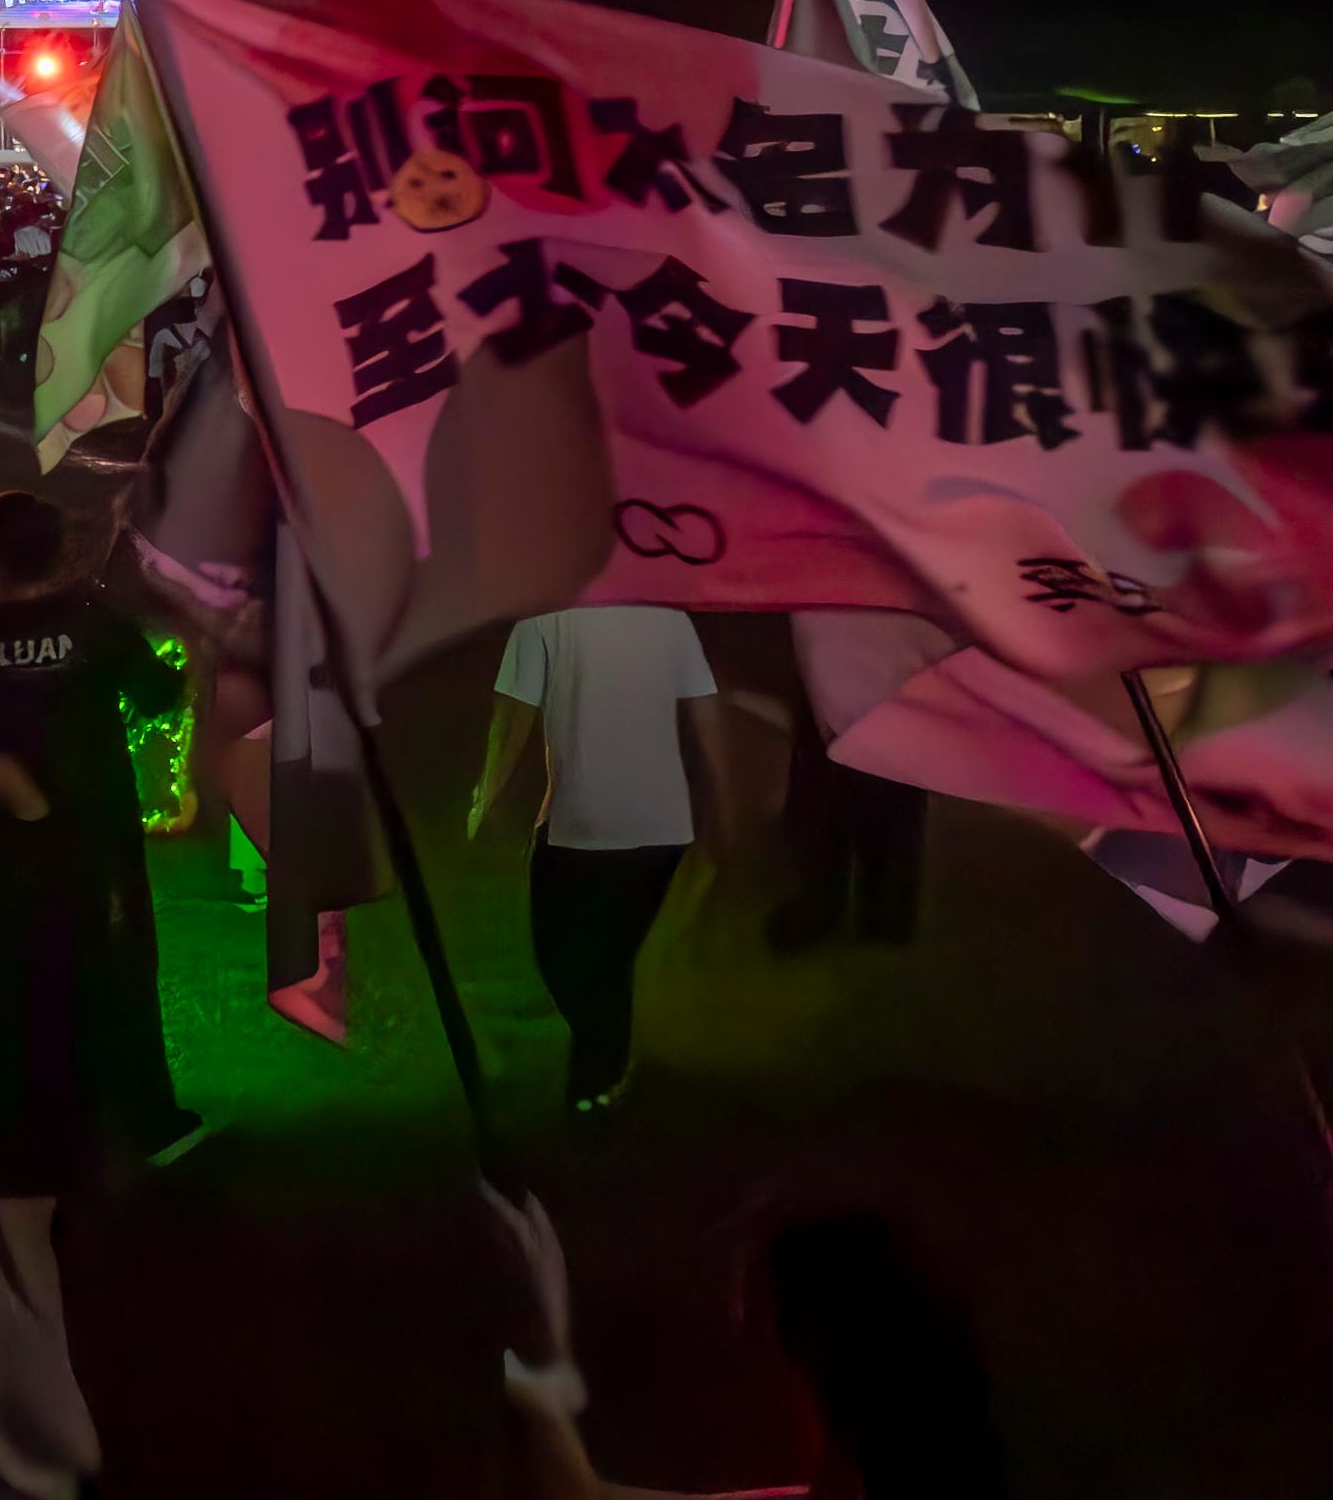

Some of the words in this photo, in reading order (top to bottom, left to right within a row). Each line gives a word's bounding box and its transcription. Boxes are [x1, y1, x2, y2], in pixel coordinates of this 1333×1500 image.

[333, 238, 1333, 452] 至少今天很快
